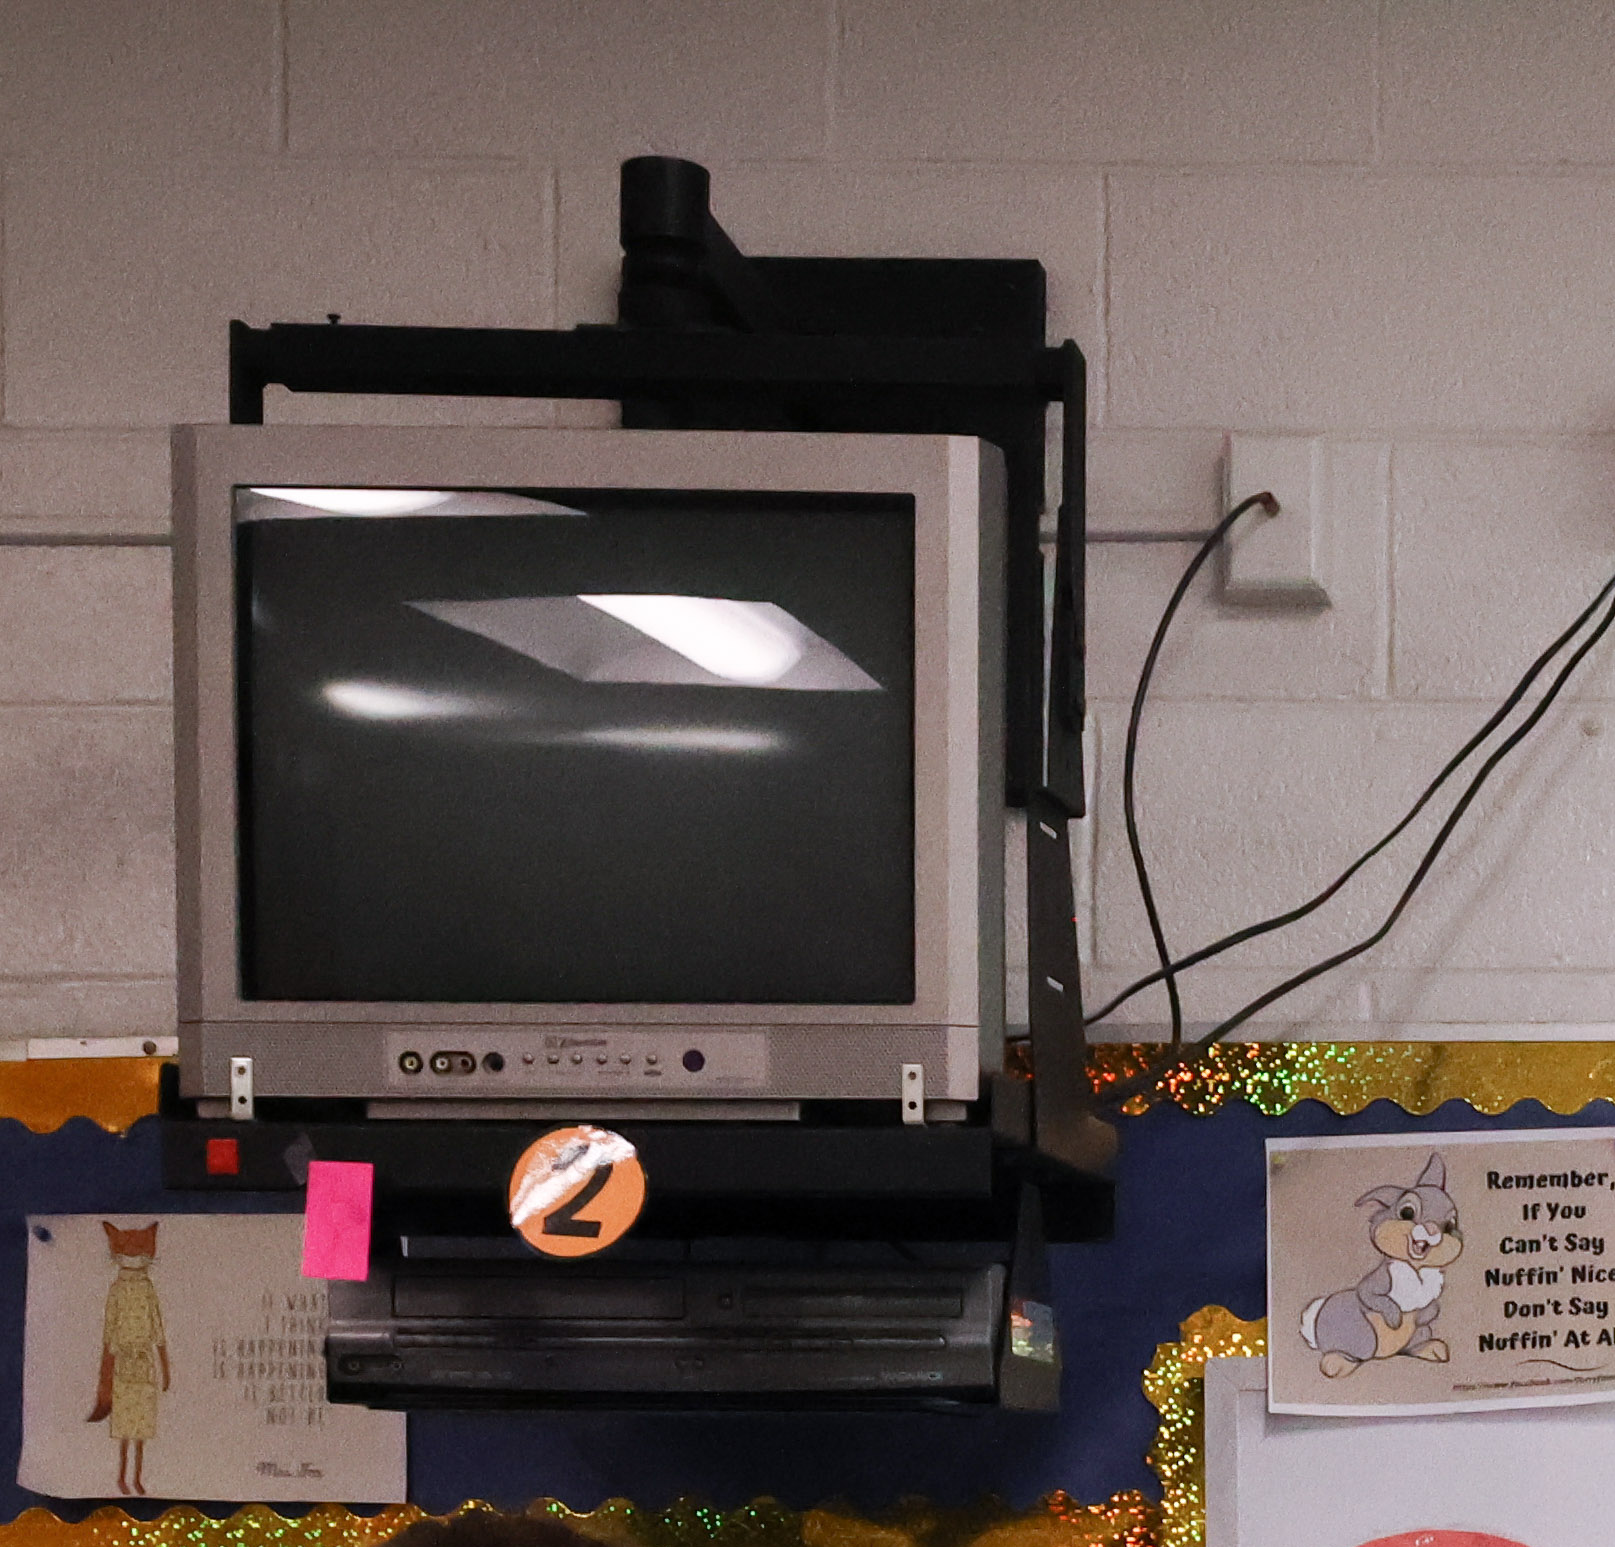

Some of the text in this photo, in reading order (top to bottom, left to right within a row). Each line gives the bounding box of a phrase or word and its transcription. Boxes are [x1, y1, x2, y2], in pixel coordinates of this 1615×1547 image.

[1522, 1203, 1587, 1222] If You
[1499, 1233, 1606, 1255] Can't Say
[1484, 1266, 1565, 1287] Nuffin'
[1503, 1298, 1609, 1319] Don't Say
[1478, 1332, 1559, 1353] Nuffin'
[1563, 1329, 1591, 1348] At
